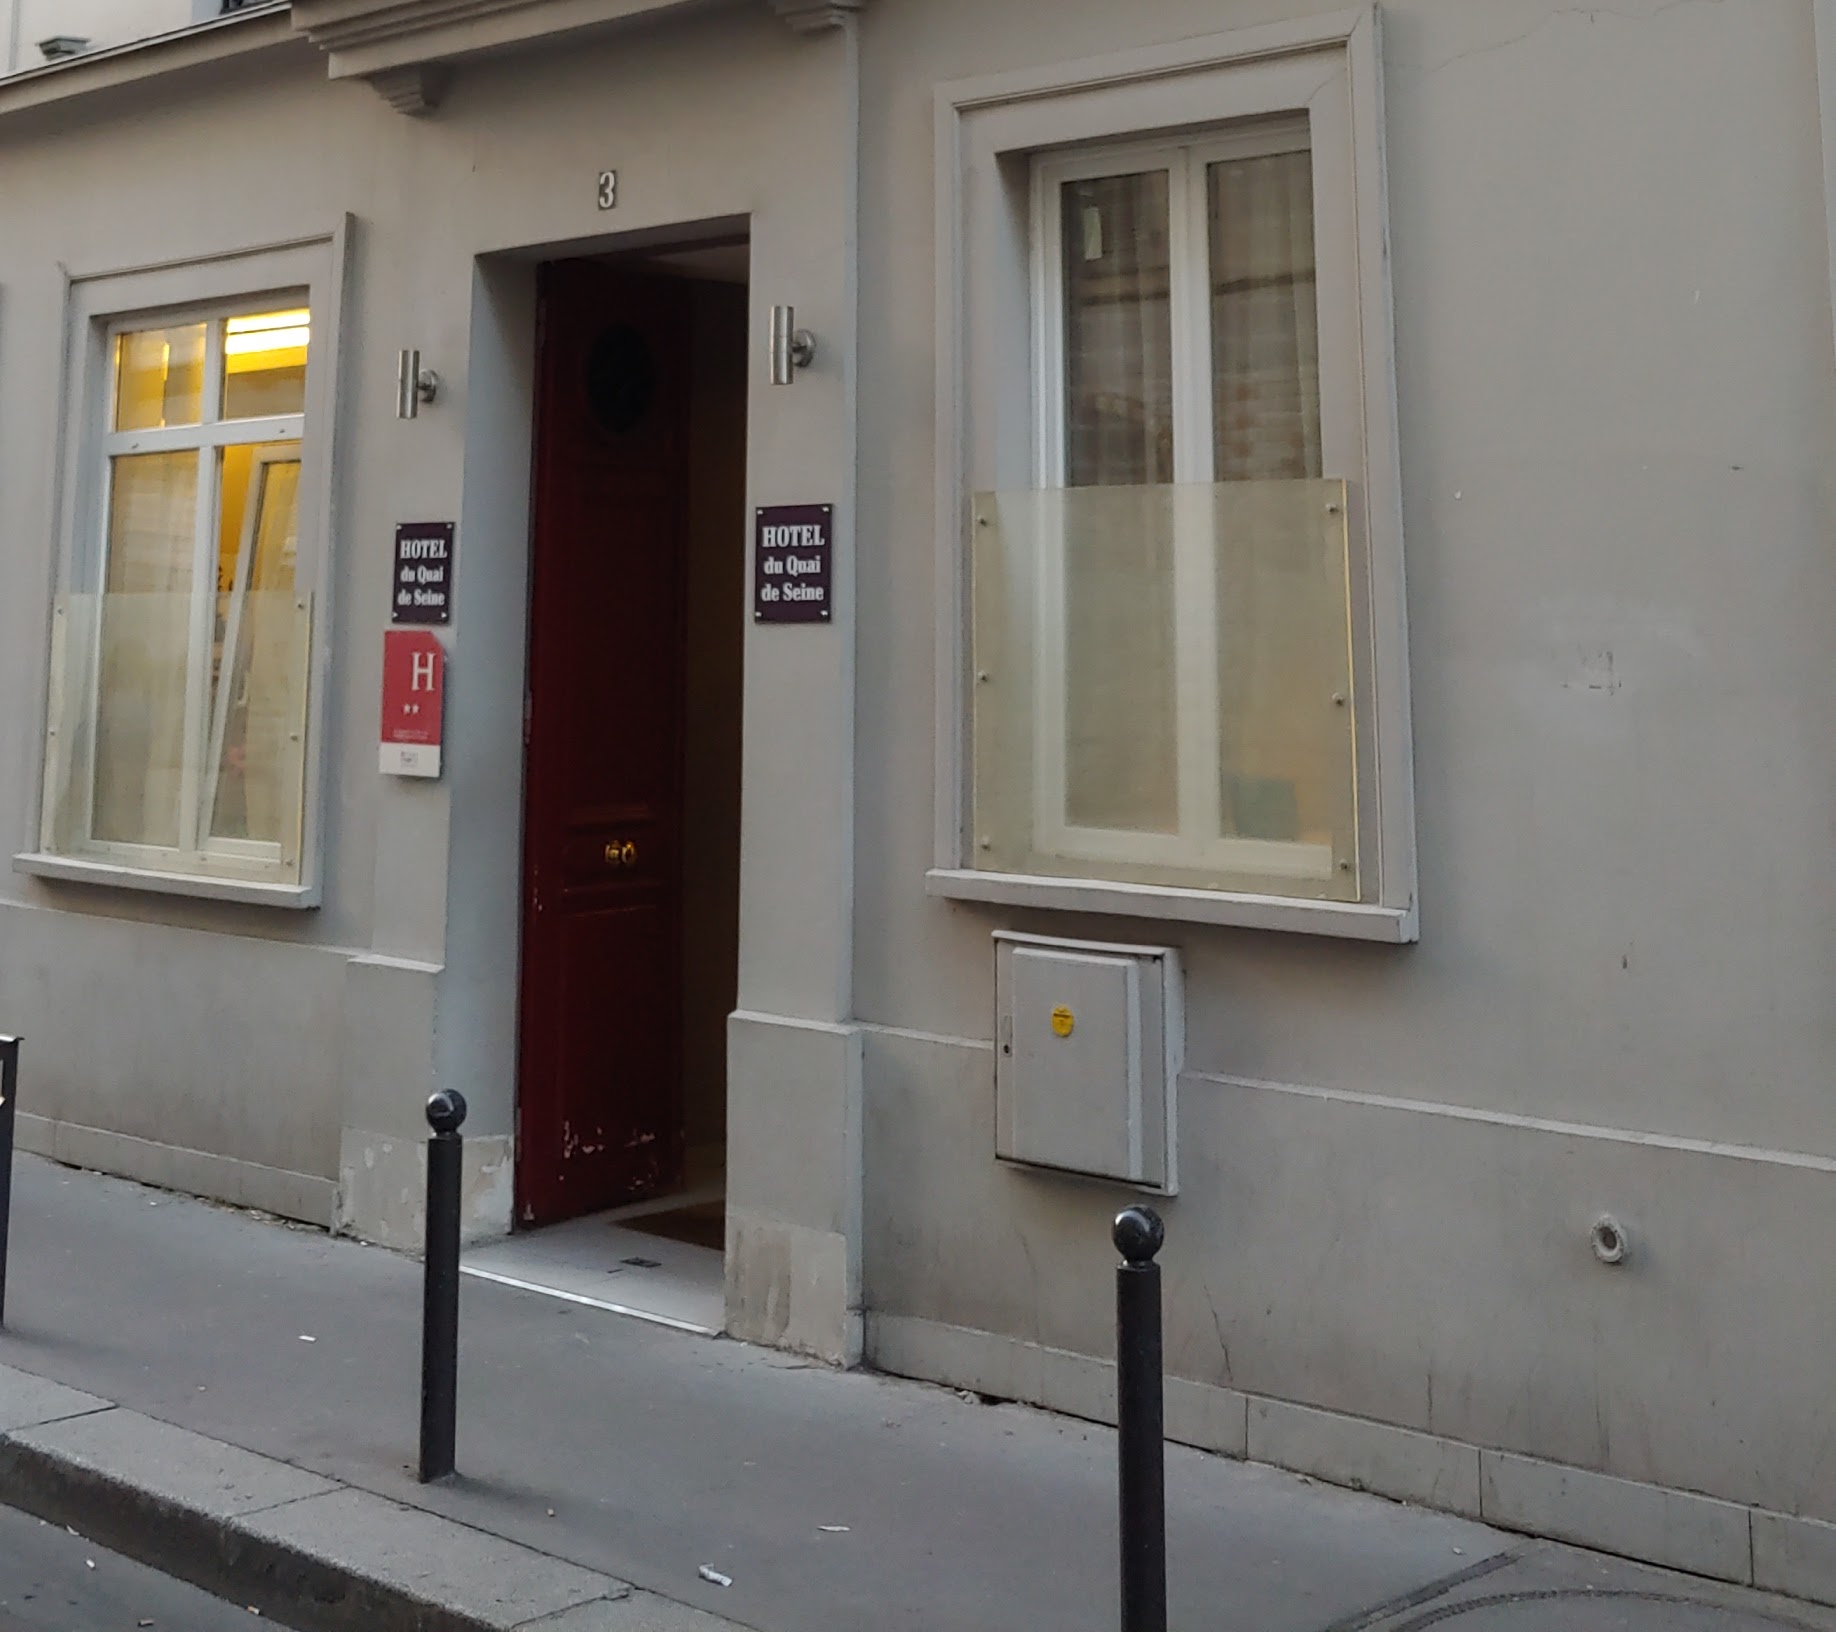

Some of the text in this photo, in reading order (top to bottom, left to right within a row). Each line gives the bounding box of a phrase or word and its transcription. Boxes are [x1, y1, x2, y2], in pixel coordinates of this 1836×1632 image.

[599, 171, 615, 208] 3
[762, 525, 825, 547] HOTEL
[400, 539, 448, 559] HOTEL
[400, 565, 444, 585] du Quai
[764, 555, 821, 577] du Quai
[397, 588, 446, 606] de Seine
[761, 582, 825, 602] de Seine
[411, 652, 435, 692] H
